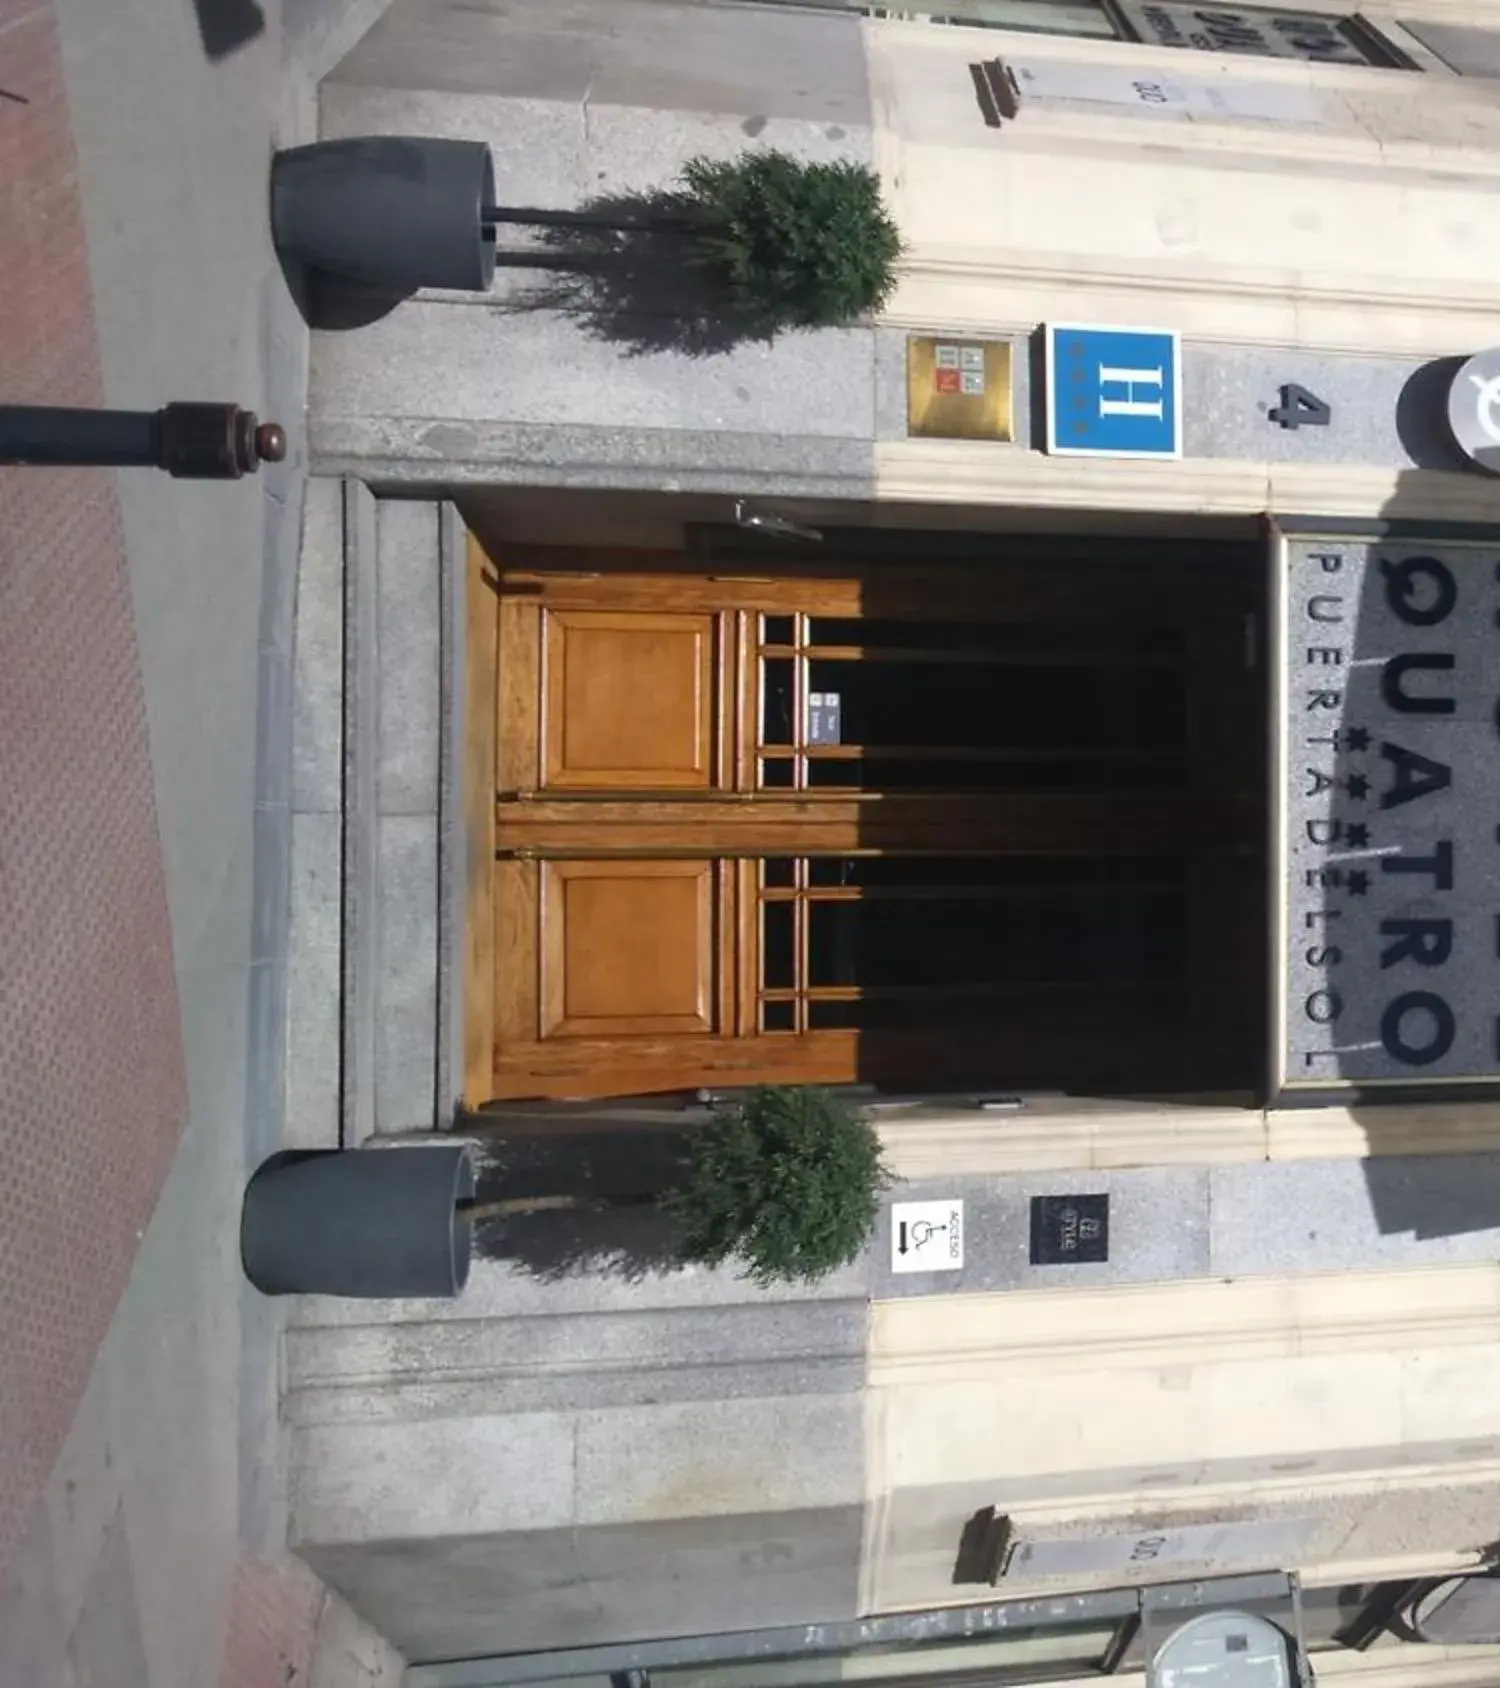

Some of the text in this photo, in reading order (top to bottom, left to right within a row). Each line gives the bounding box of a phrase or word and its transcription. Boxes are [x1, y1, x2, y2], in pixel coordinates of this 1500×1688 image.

[1098, 361, 1163, 423] H
[1268, 383, 1331, 430] 4
[1380, 556, 1458, 1066] QUATRO
